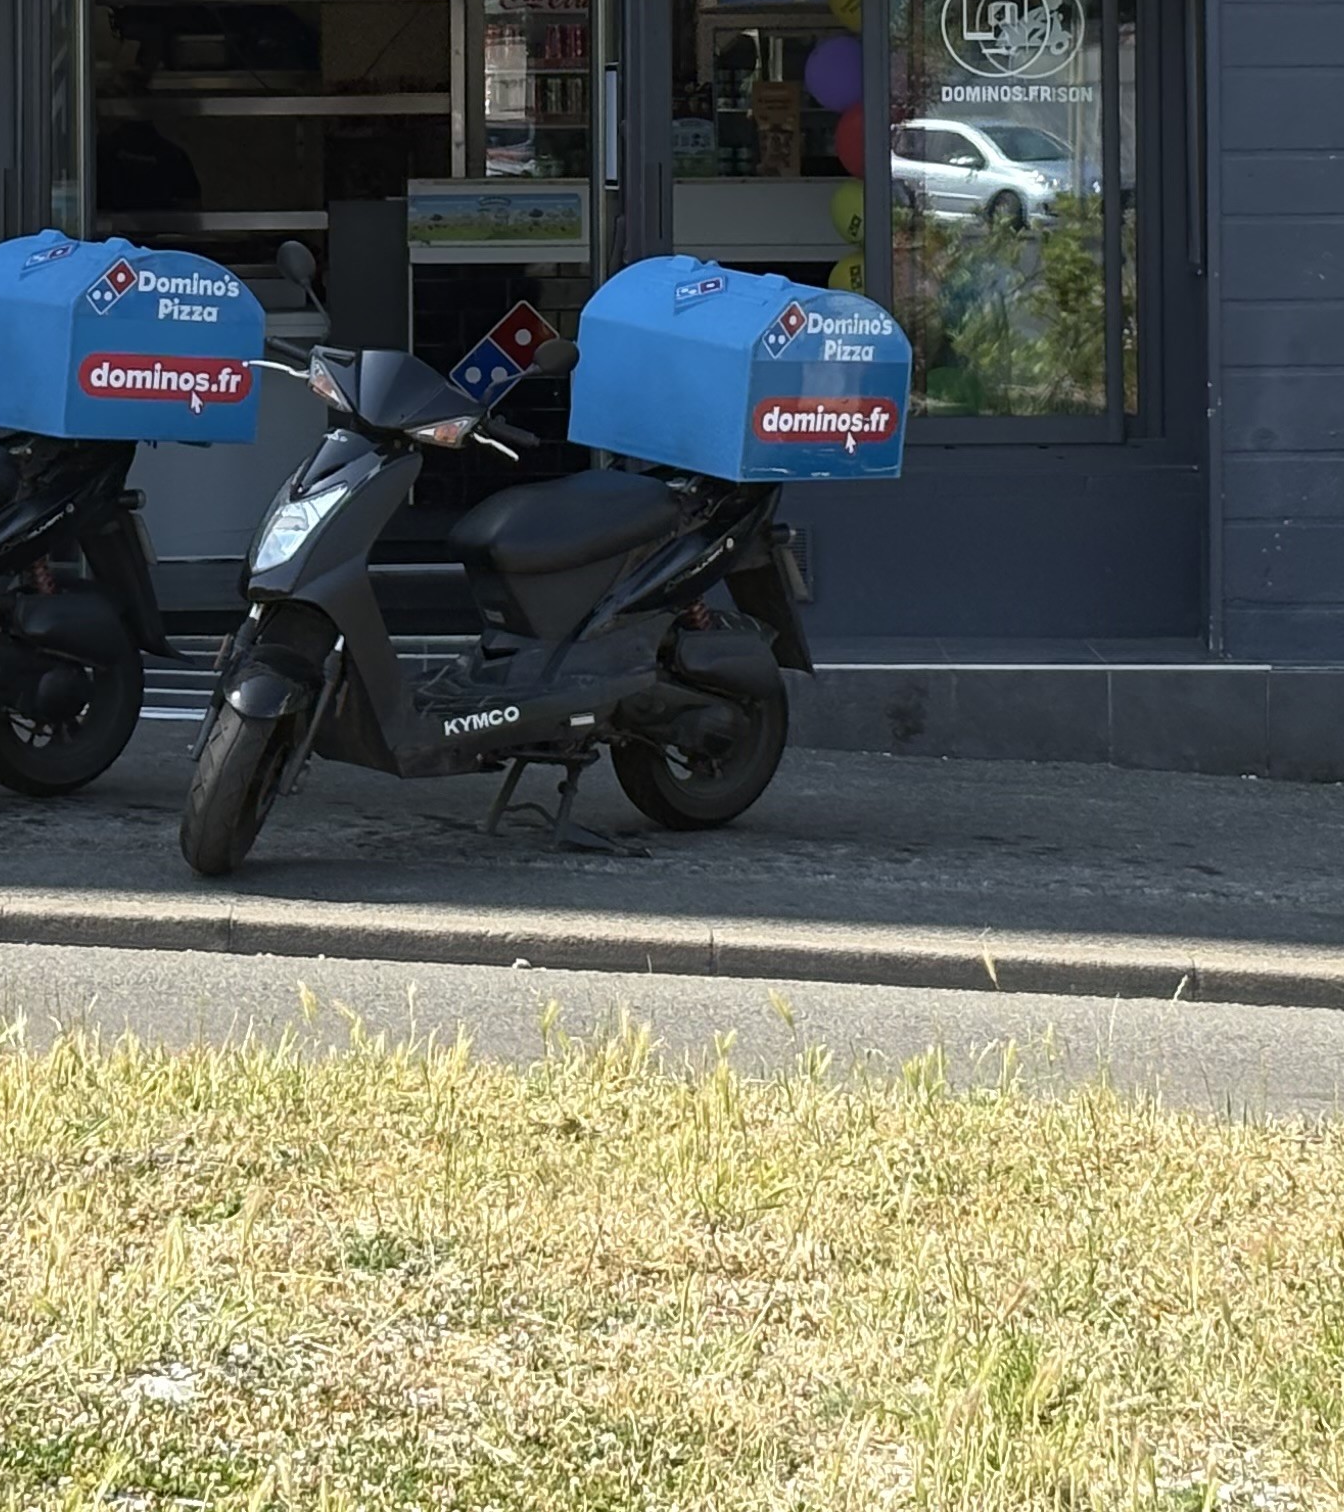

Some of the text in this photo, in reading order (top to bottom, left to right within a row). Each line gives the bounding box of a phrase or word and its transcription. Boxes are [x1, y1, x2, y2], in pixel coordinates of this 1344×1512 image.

[138, 270, 240, 298] Domino's
[158, 298, 218, 323] Pizza
[807, 312, 893, 336] Domino's
[824, 339, 875, 361] Pizza
[90, 361, 242, 393] dominos.fr
[762, 405, 890, 433] dominos.fr
[443, 706, 520, 736] KYMCO
